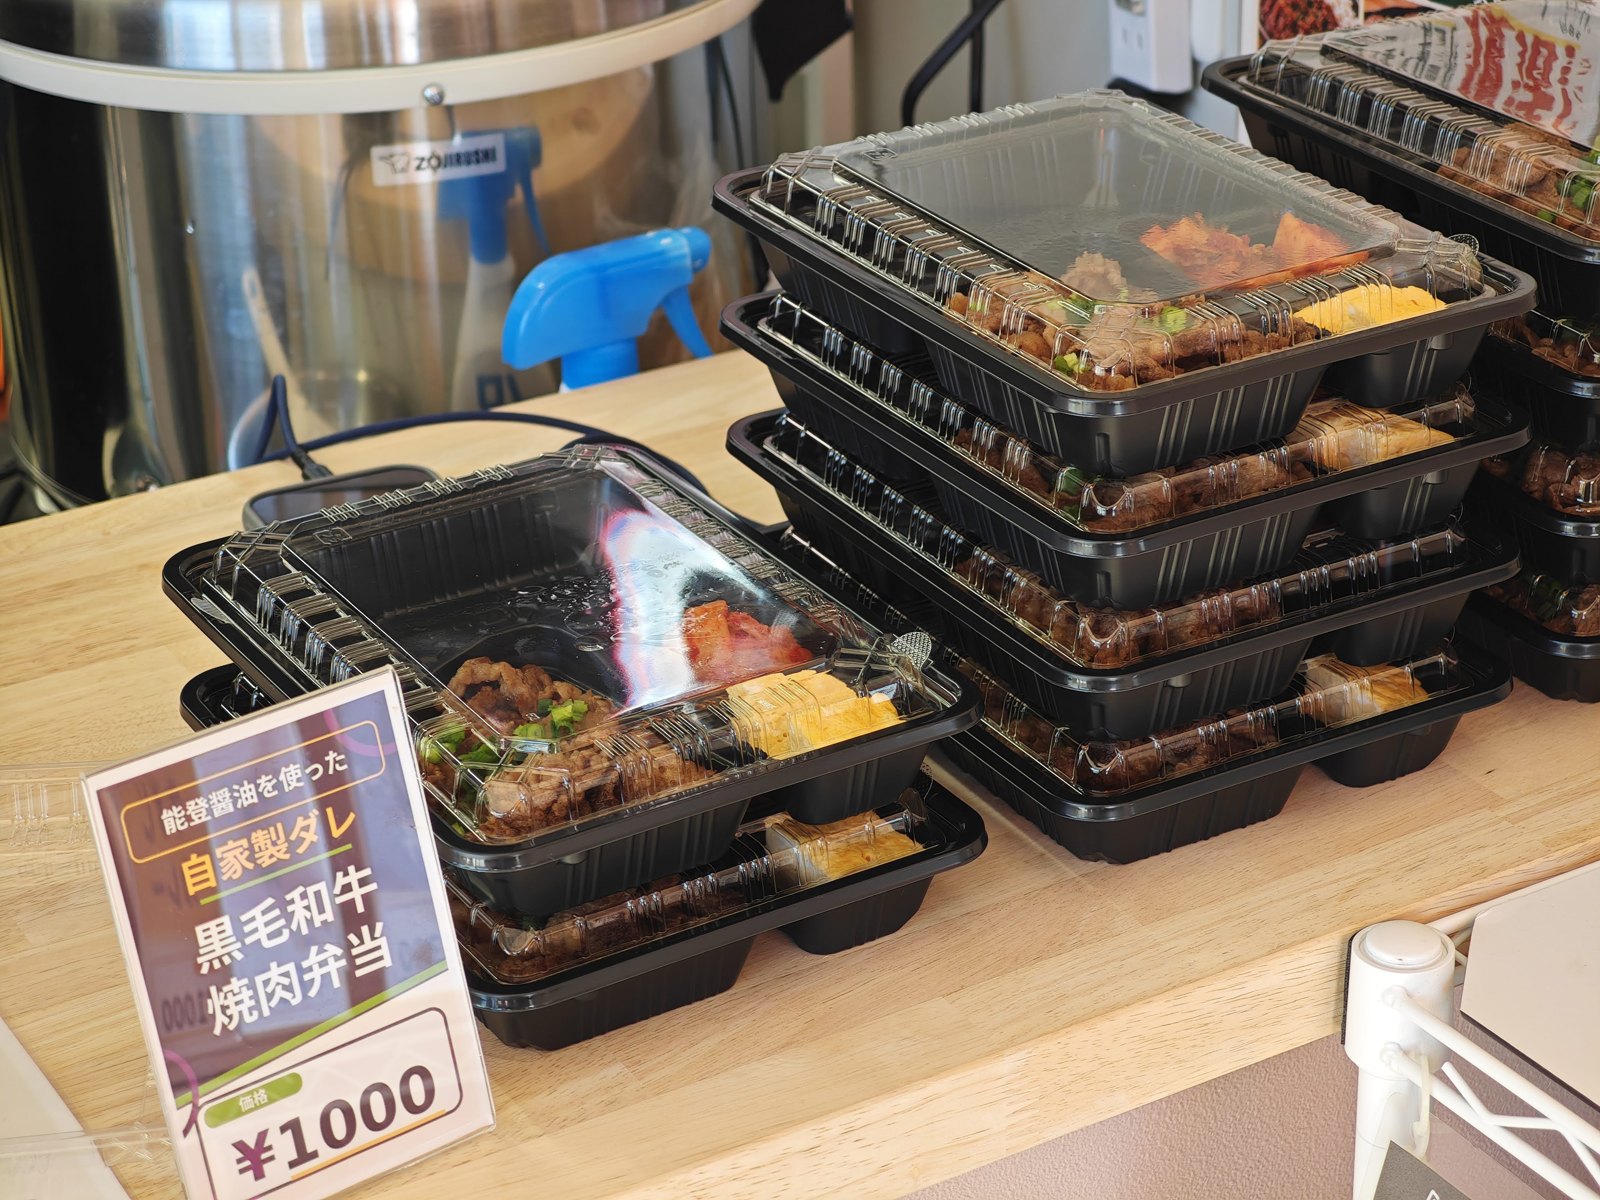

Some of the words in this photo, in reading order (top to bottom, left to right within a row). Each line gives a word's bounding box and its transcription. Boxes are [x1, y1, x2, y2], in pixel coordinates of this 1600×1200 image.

[415, 146, 497, 173] ZOJIRUSHI
[160, 750, 349, 836] 能登醤油を使った
[180, 806, 356, 897] 自家製ダレ
[195, 865, 379, 976] 黒毛和牛
[206, 921, 394, 1037] 焼肉弁当
[231, 1065, 436, 1183] ¥1000
[238, 1088, 269, 1114] 価格
